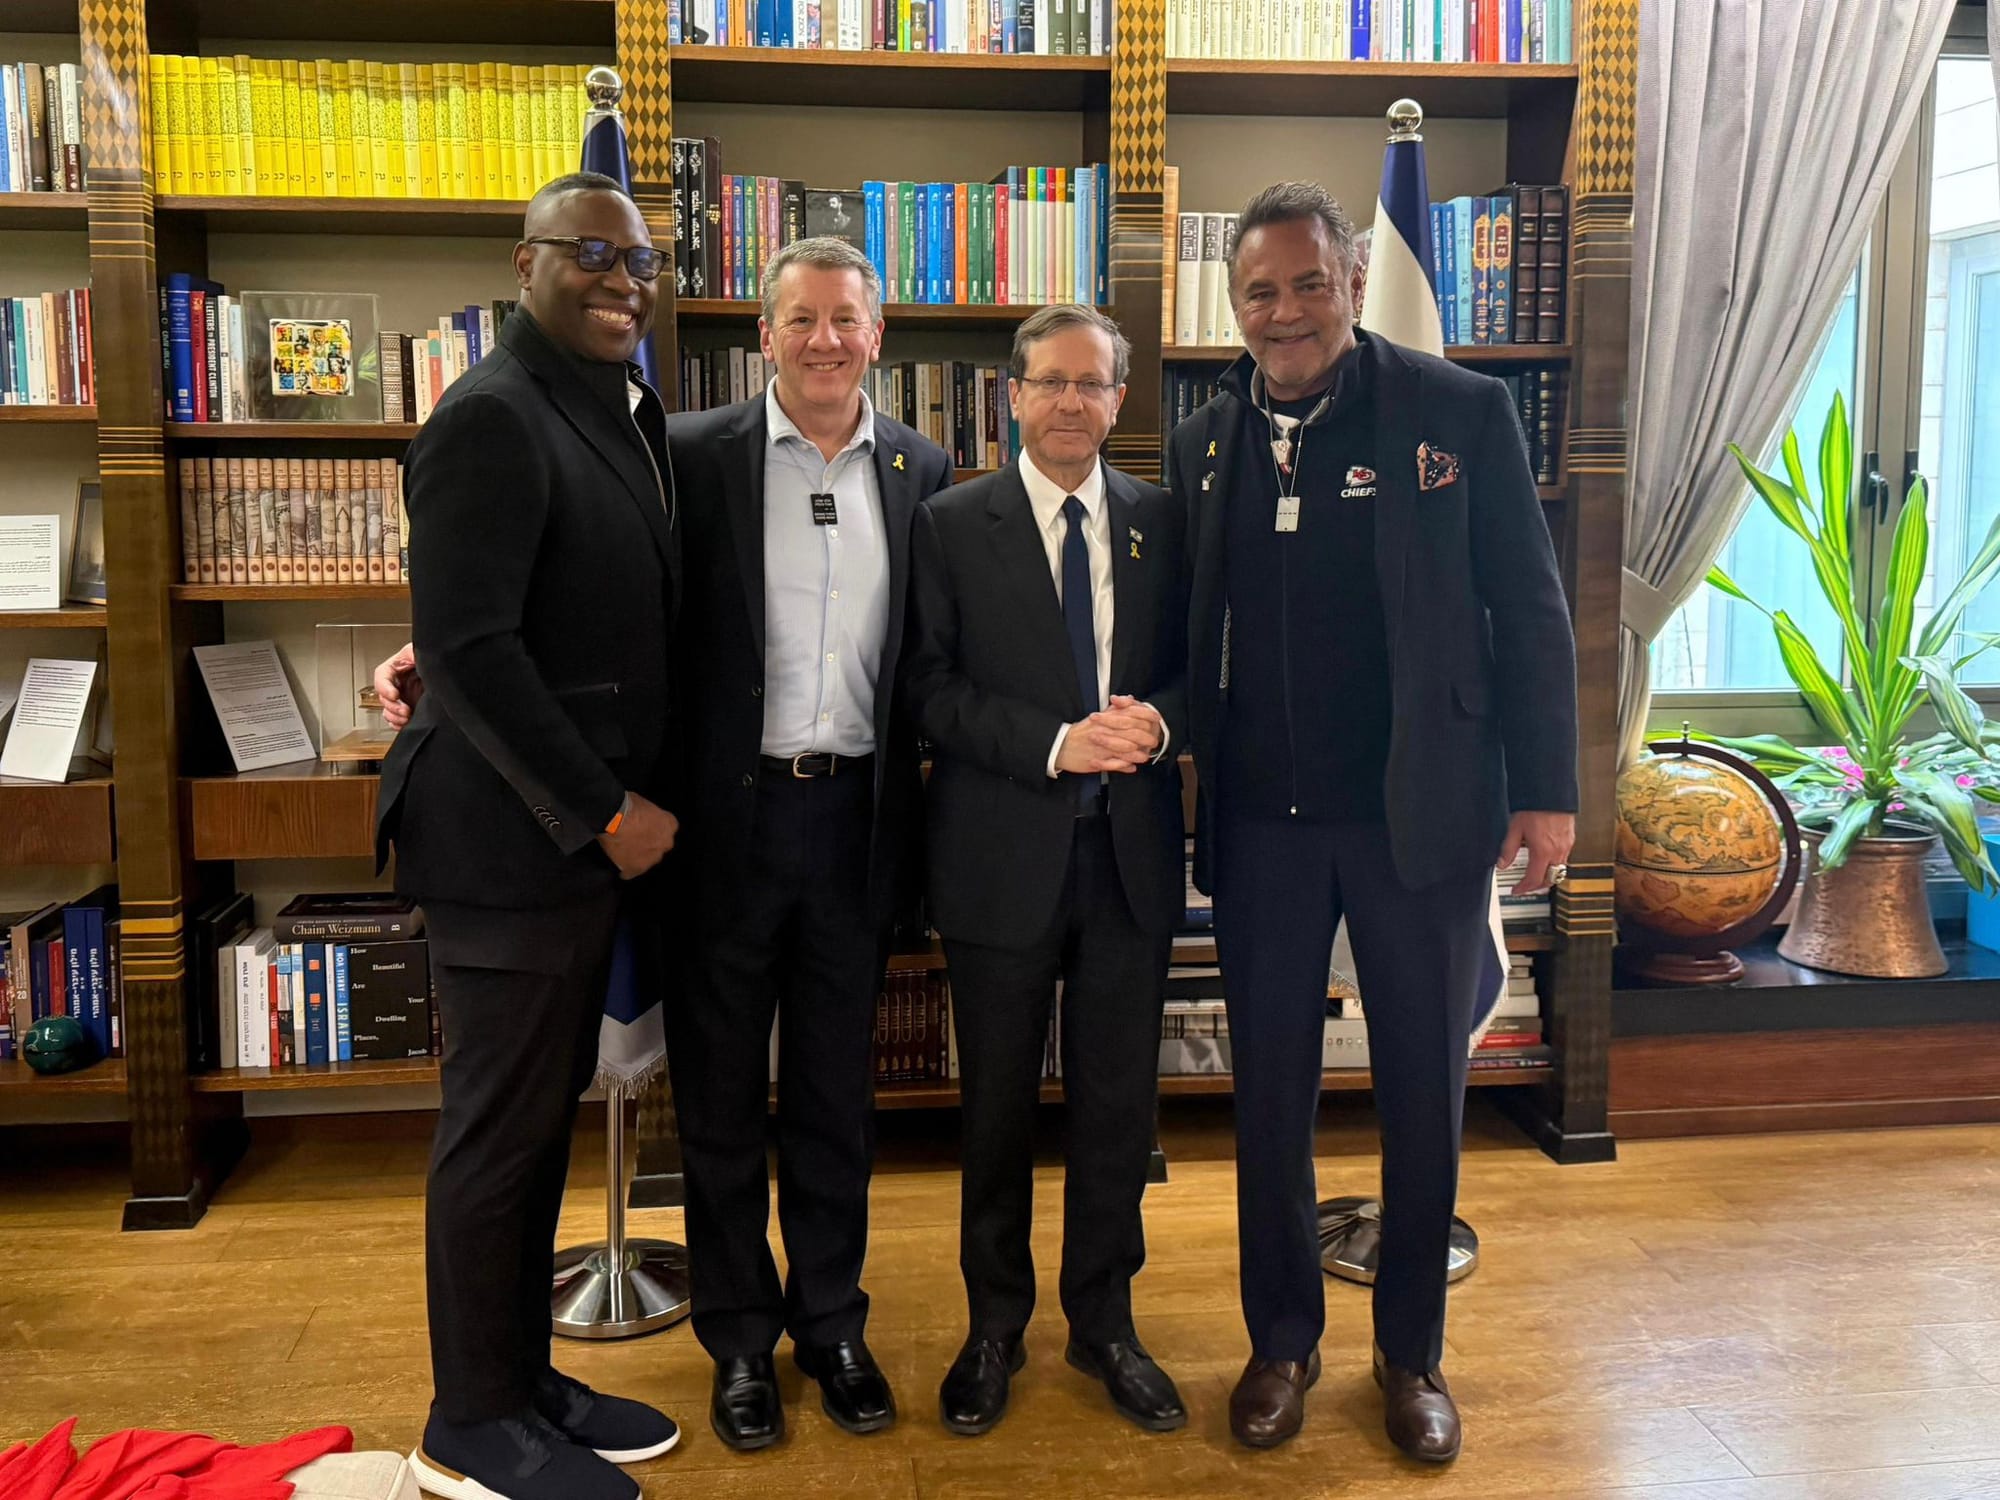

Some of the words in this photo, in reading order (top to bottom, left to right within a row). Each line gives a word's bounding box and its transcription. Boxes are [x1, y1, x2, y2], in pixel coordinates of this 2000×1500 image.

[690, 218, 700, 250] ישראל
[1183, 219, 1193, 236] חיים
[206, 306, 216, 331] LETTERS
[207, 339, 217, 371] PRESIDENT
[208, 372, 218, 398] CLINTON
[292, 924, 325, 935] Chaim
[328, 923, 380, 934] Weizmann
[70, 948, 80, 968] מילון
[89, 948, 99, 968] מילון
[372, 962, 405, 971] Beautiful
[71, 970, 80, 1018] עיברי-אמהרי
[90, 970, 100, 1018] עיברי-אמהרי
[337, 1002, 349, 1043] ISRAEL
